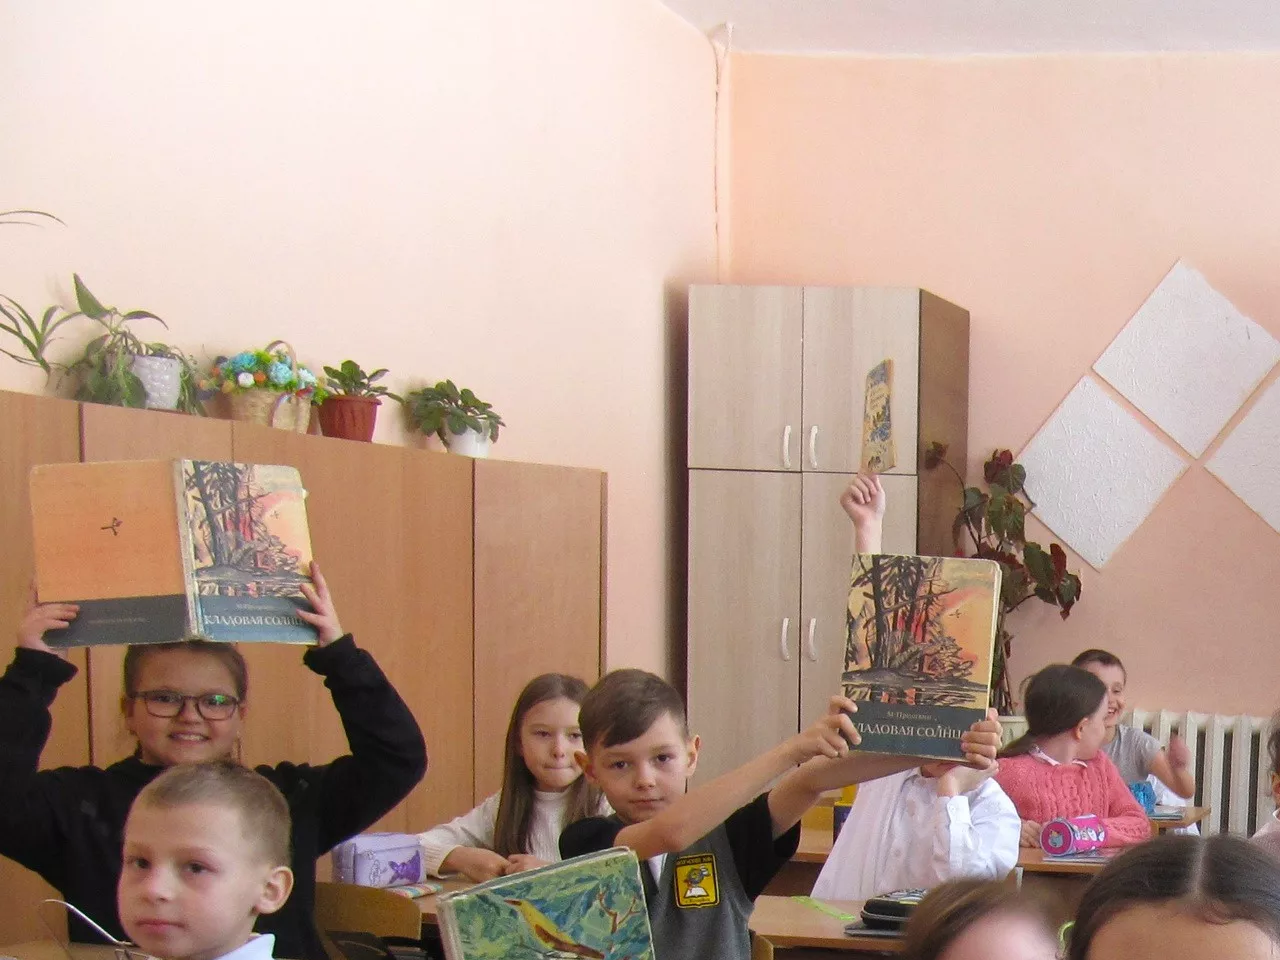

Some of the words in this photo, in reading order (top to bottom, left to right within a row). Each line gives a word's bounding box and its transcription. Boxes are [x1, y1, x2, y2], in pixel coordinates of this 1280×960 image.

[204, 615, 263, 627] КЛАДОВАЯ
[857, 721, 915, 737] ЛАДОВАЯ
[916, 723, 966, 740] СОЛНЦ
